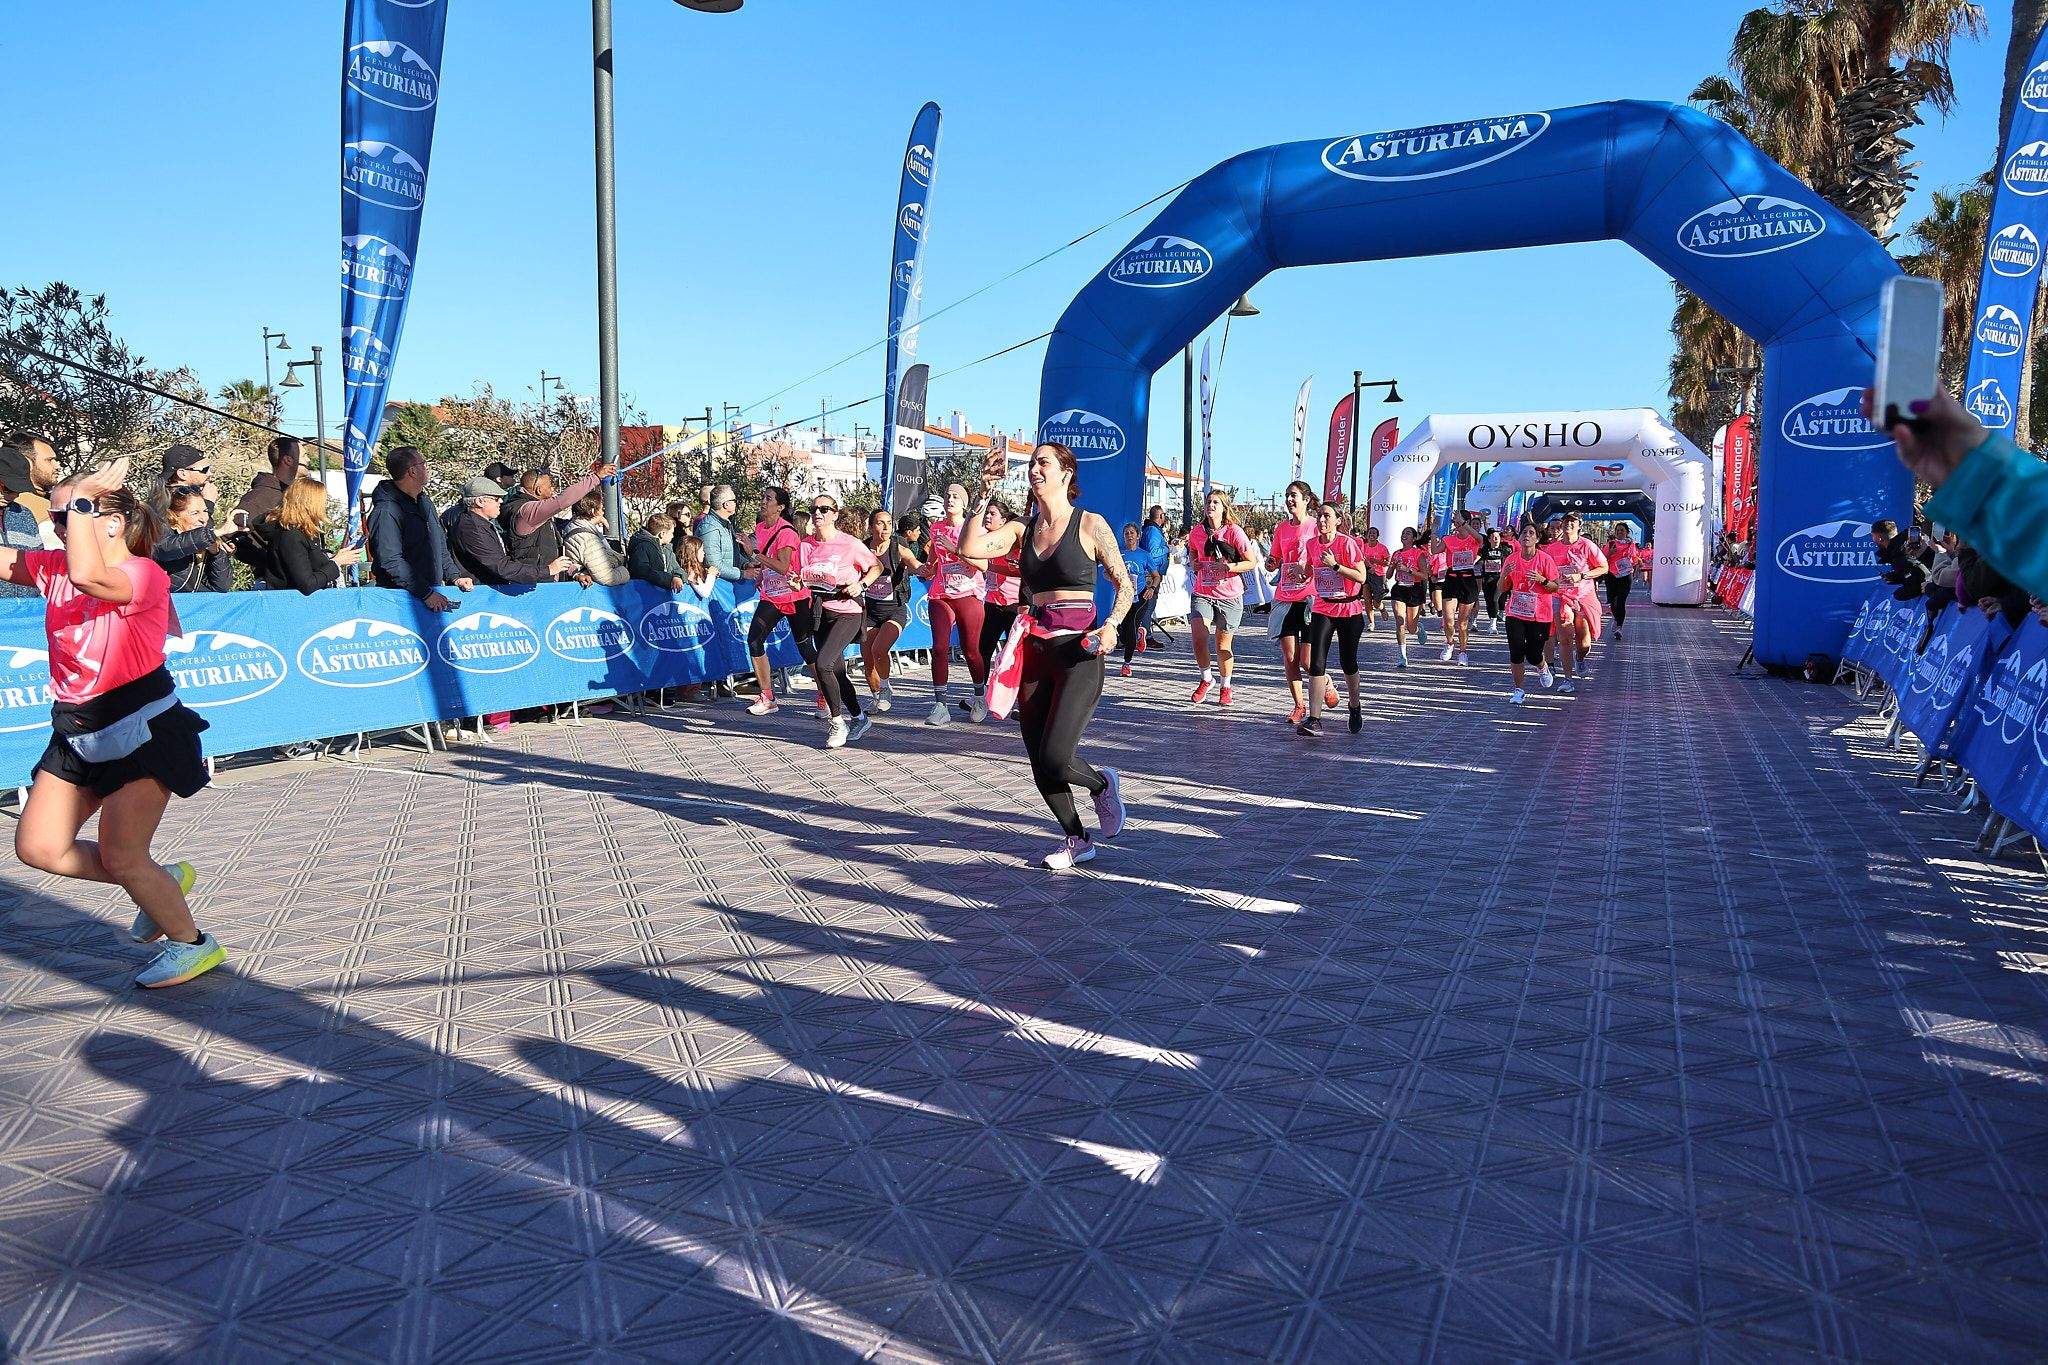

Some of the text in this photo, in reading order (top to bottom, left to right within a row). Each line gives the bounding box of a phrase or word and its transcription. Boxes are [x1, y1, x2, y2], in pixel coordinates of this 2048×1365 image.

[348, 54, 433, 101] ASTURIANA
[1375, 125, 1444, 140] CENTRAL
[1336, 119, 1531, 166] ASTURIANA
[1710, 211, 1810, 227] CENTRAL LECHERA
[1688, 218, 1817, 248] ASTURIANA
[1991, 240, 2034, 266] ASTURIANA
[1113, 258, 1204, 277] ASTURIANA
[1811, 409, 1858, 417] CENTRAL
[1041, 429, 1119, 451] ASTURIANA
[1467, 421, 1602, 450] OYSHO
[1333, 415, 1347, 483] Santander
[1392, 454, 1430, 463] OYSHO
[1641, 447, 1685, 458] OYSHO
[1733, 435, 1743, 495] Santander
[896, 473, 924, 485] OYSHO
[1373, 503, 1408, 512] OYSHO
[1560, 499, 1627, 507] VOLVO
[1662, 502, 1704, 512] OYSHO
[1659, 555, 1700, 567] OYSHO
[1784, 543, 1886, 567] ASTURIA
[459, 633, 493, 642] CENTRAL
[555, 628, 631, 651] ASTURIANA
[648, 621, 712, 642] ASTURIANA
[327, 637, 417, 653] CENTRAL LECHERA
[448, 637, 534, 662] ASTURIANA
[217, 650, 268, 661] LECHERA
[311, 646, 425, 675] ASTURIANA
[20, 671, 47, 682] LEC
[173, 660, 279, 689] TURIANA
